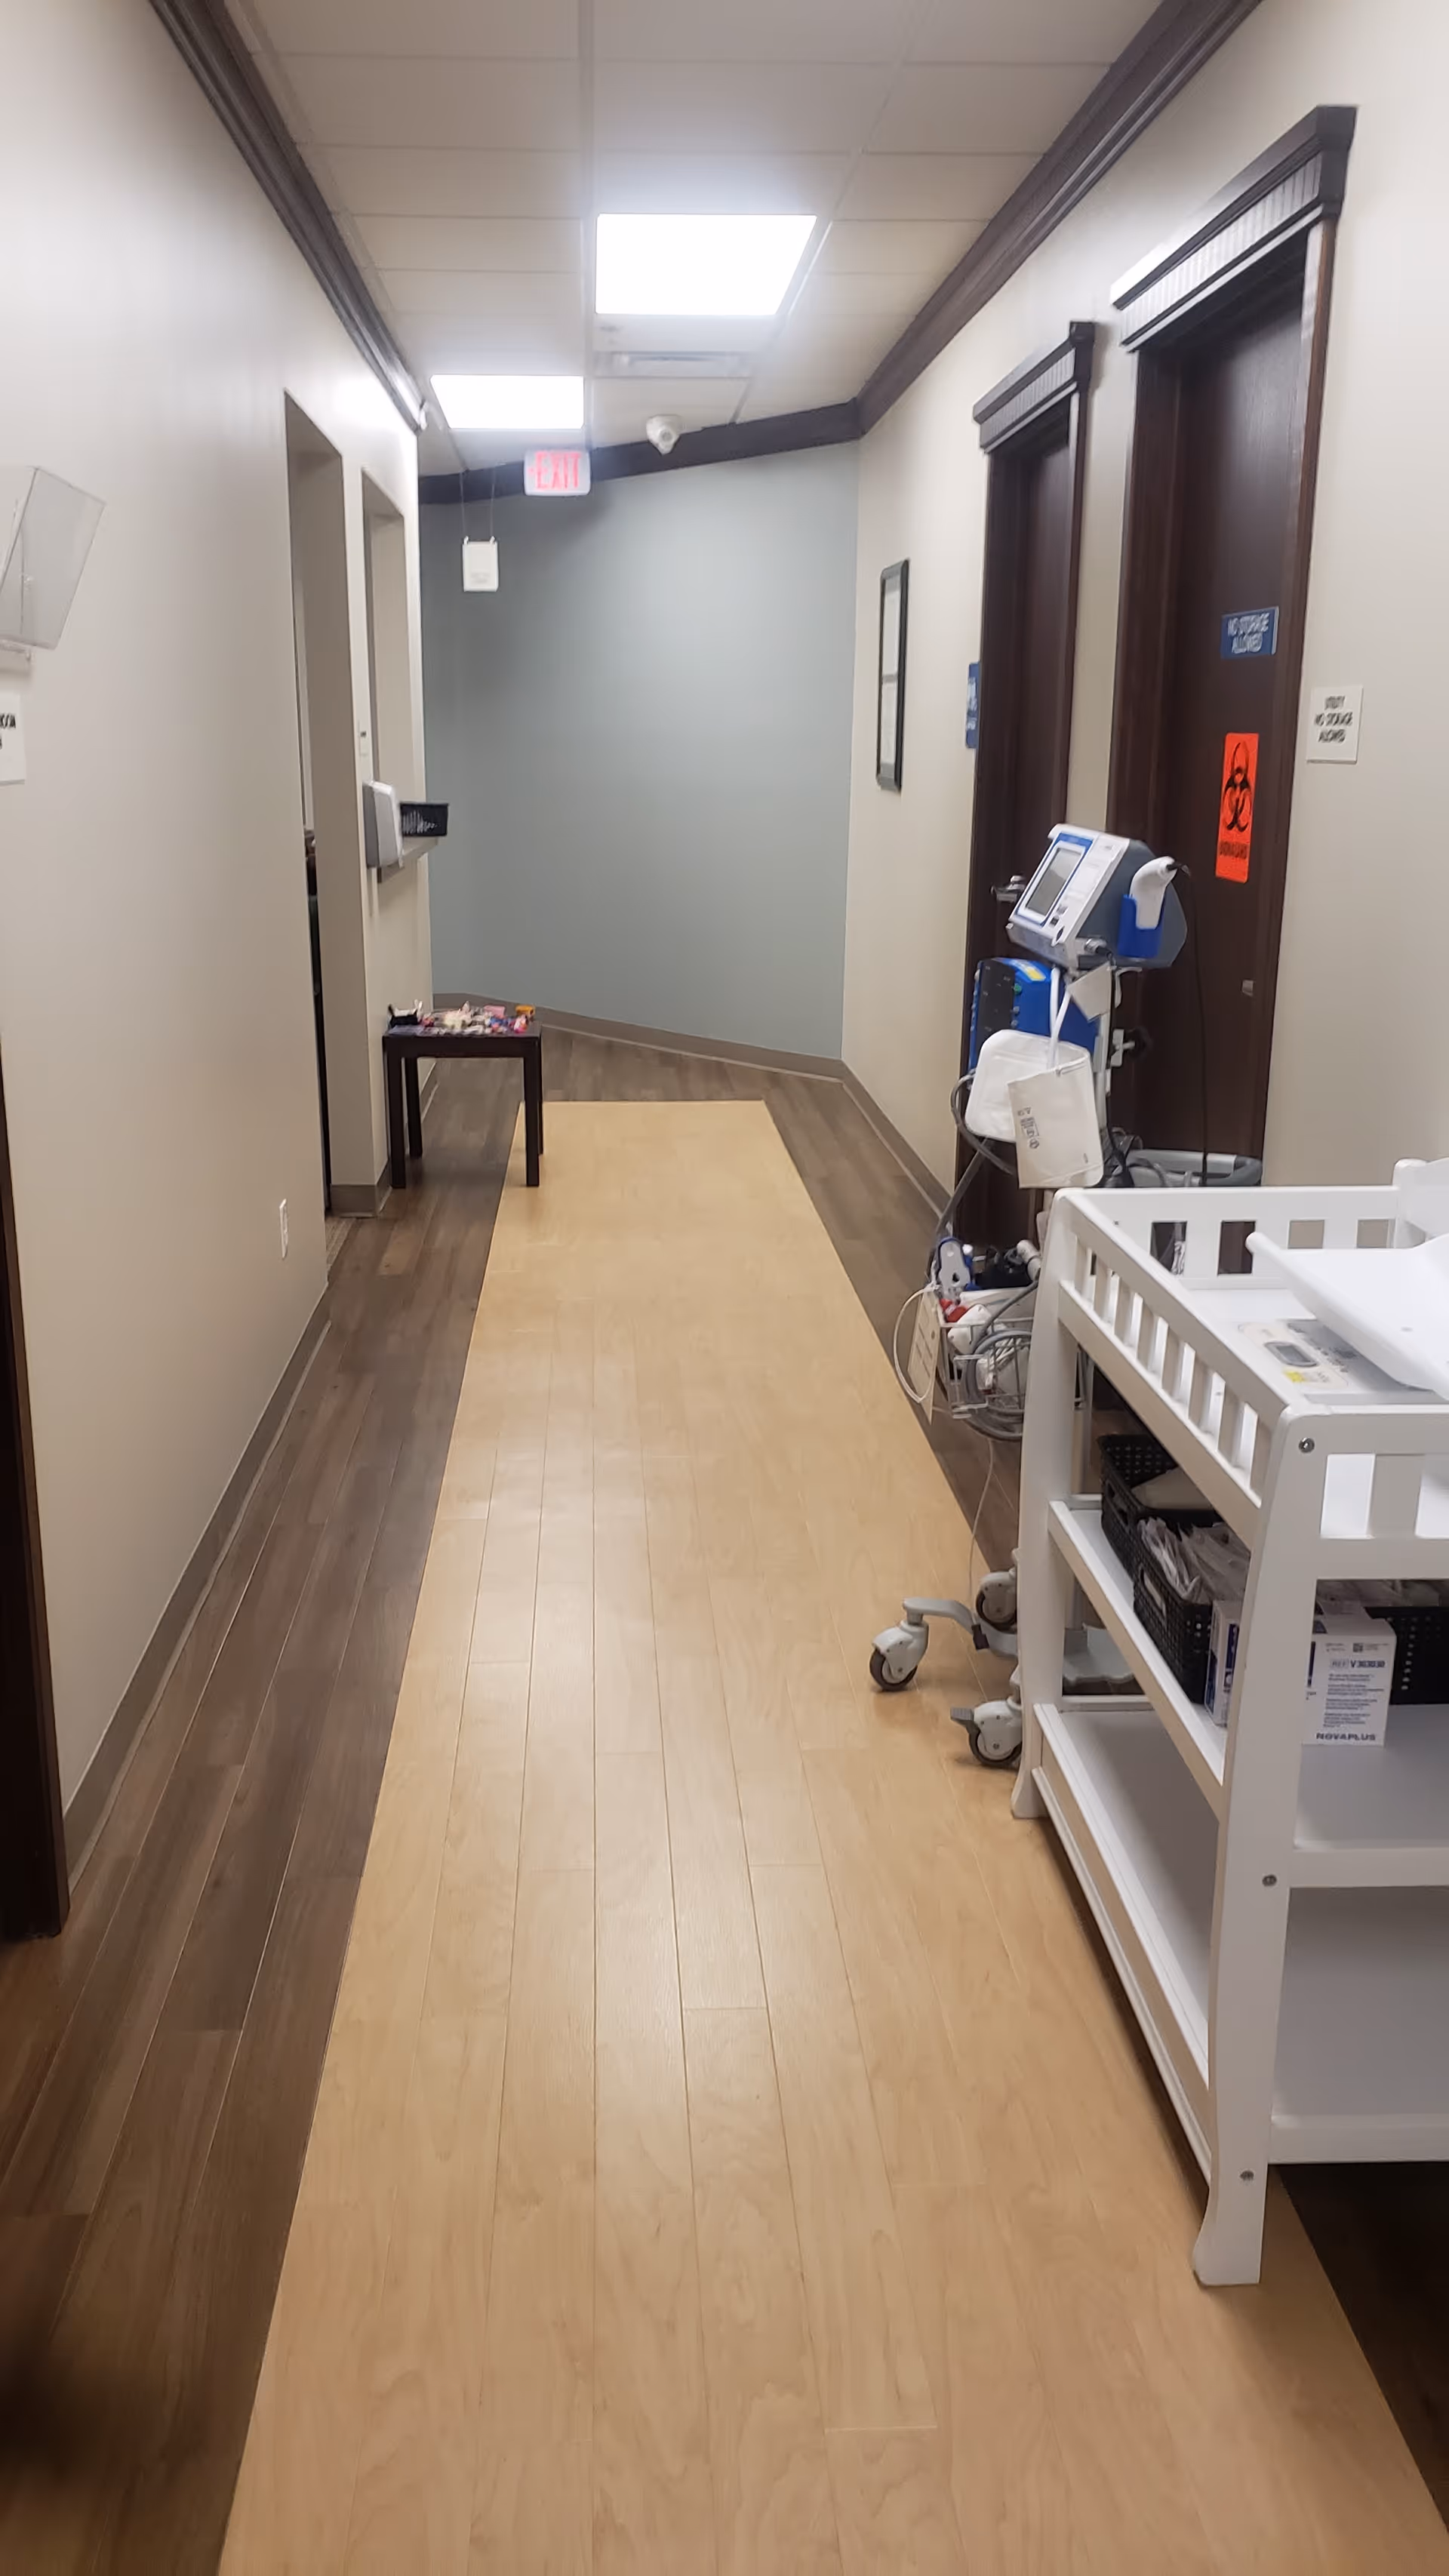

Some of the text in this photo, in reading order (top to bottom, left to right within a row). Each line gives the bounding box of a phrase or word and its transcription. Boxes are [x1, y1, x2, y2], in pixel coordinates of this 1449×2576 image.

[535, 451, 581, 490] EXIT
[1227, 617, 1238, 636] NO
[1315, 713, 1325, 726] NO
[1315, 1732, 1376, 1741] NOVAPLUS
